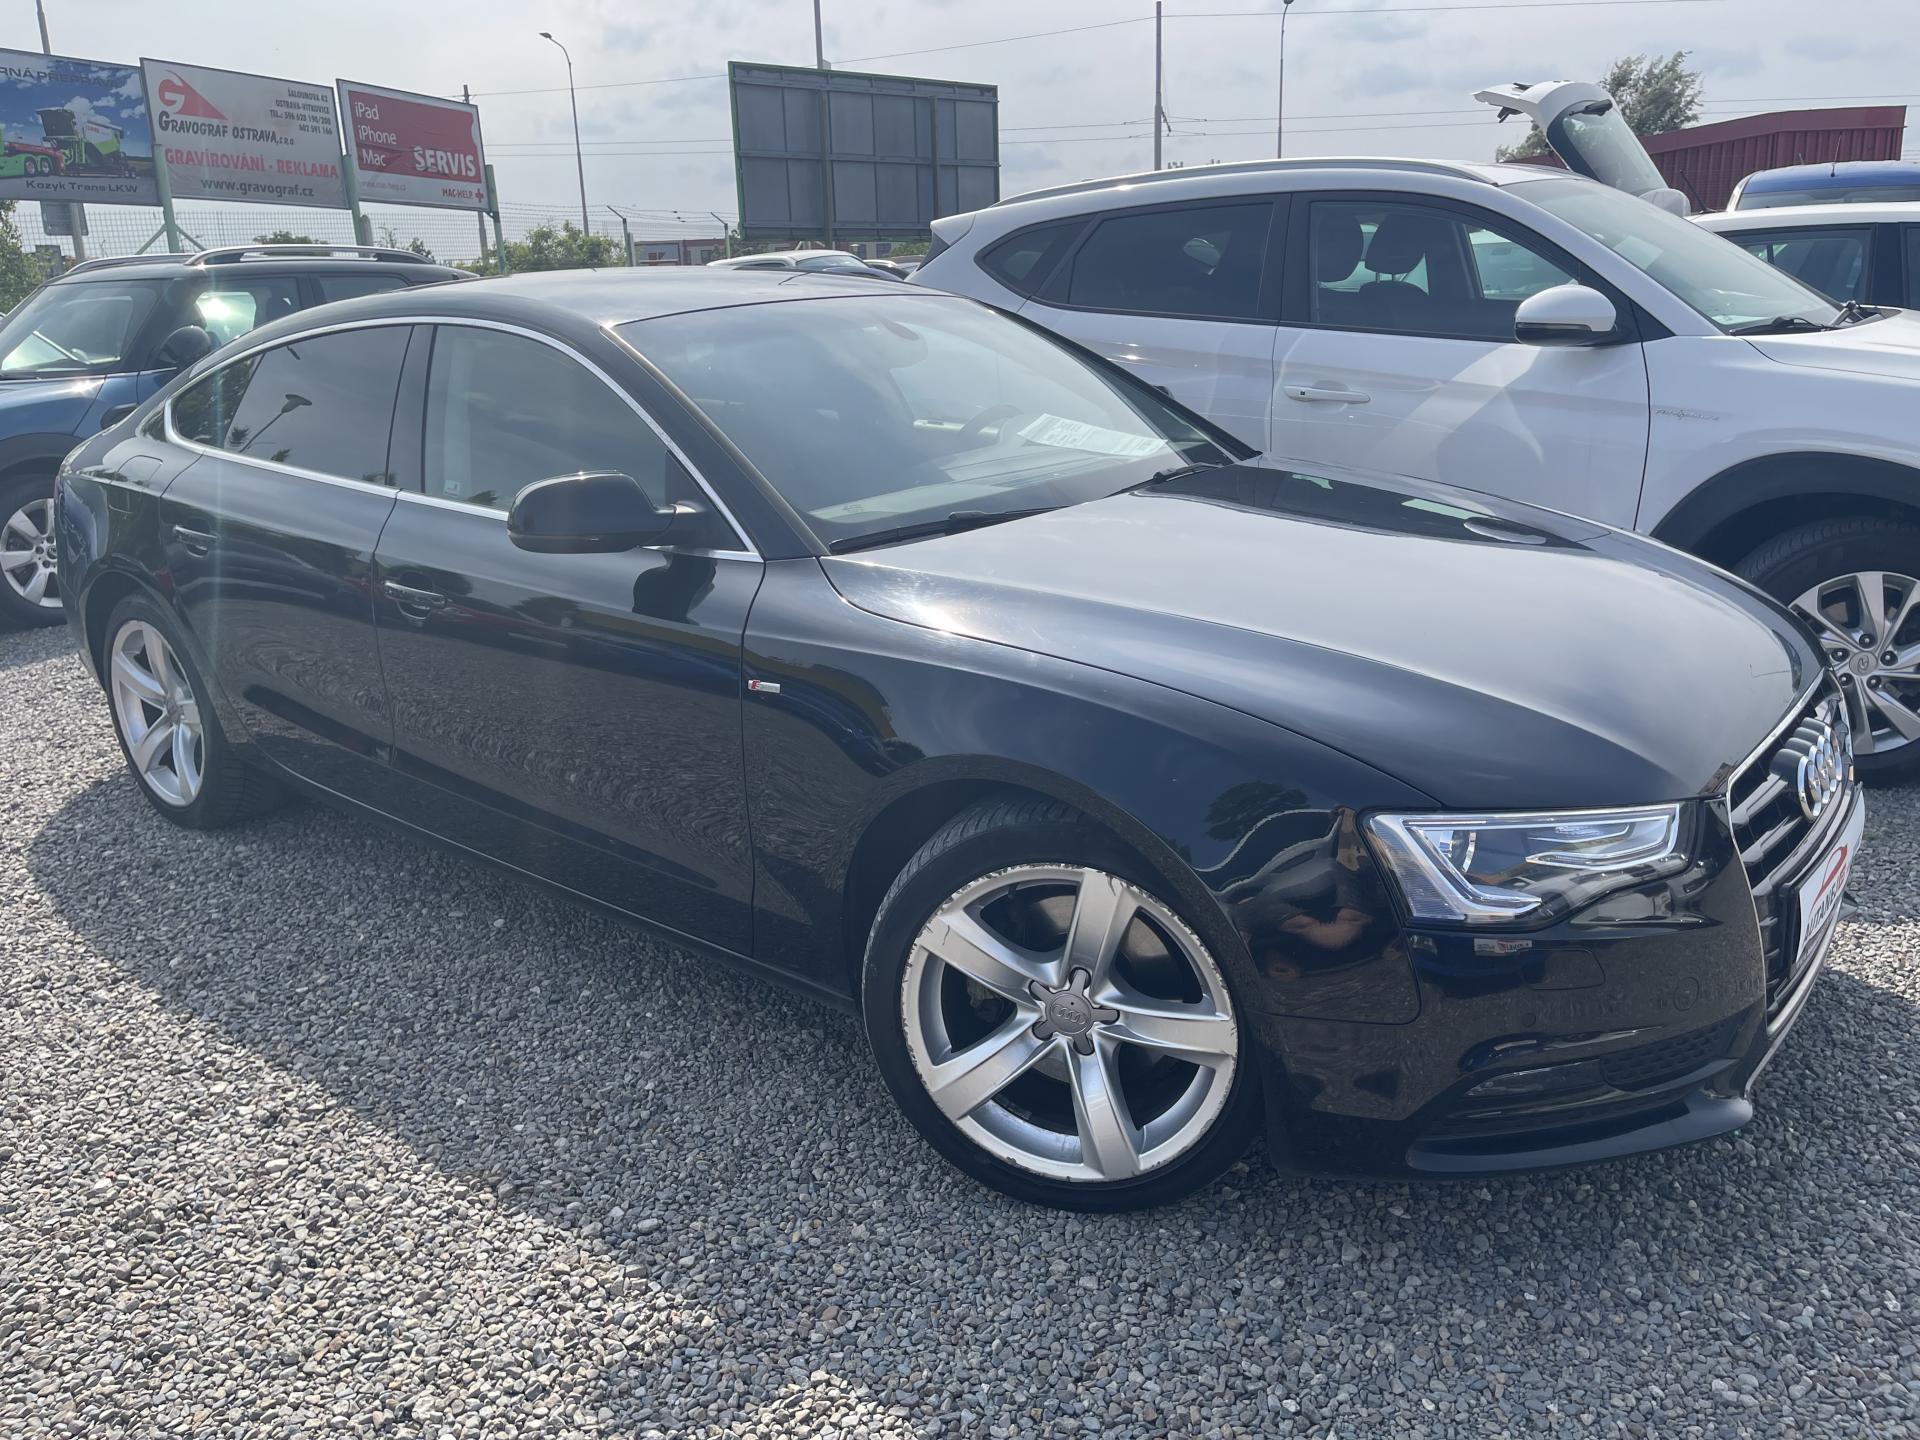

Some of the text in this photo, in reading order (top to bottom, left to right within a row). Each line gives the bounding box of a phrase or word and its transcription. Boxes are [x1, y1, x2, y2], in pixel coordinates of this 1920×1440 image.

[354, 102, 380, 120] iPad
[158, 111, 228, 138] GRAVOGRAF
[357, 125, 397, 145] iPhone
[164, 148, 266, 172] GRAVÍROVÁNÍ
[276, 159, 340, 179] REKLAMA
[361, 149, 386, 167] Mac
[414, 146, 477, 177] SERVIS
[25, 180, 138, 193] Kozyk Trans LKW
[200, 179, 315, 198] www.gravograf.cz
